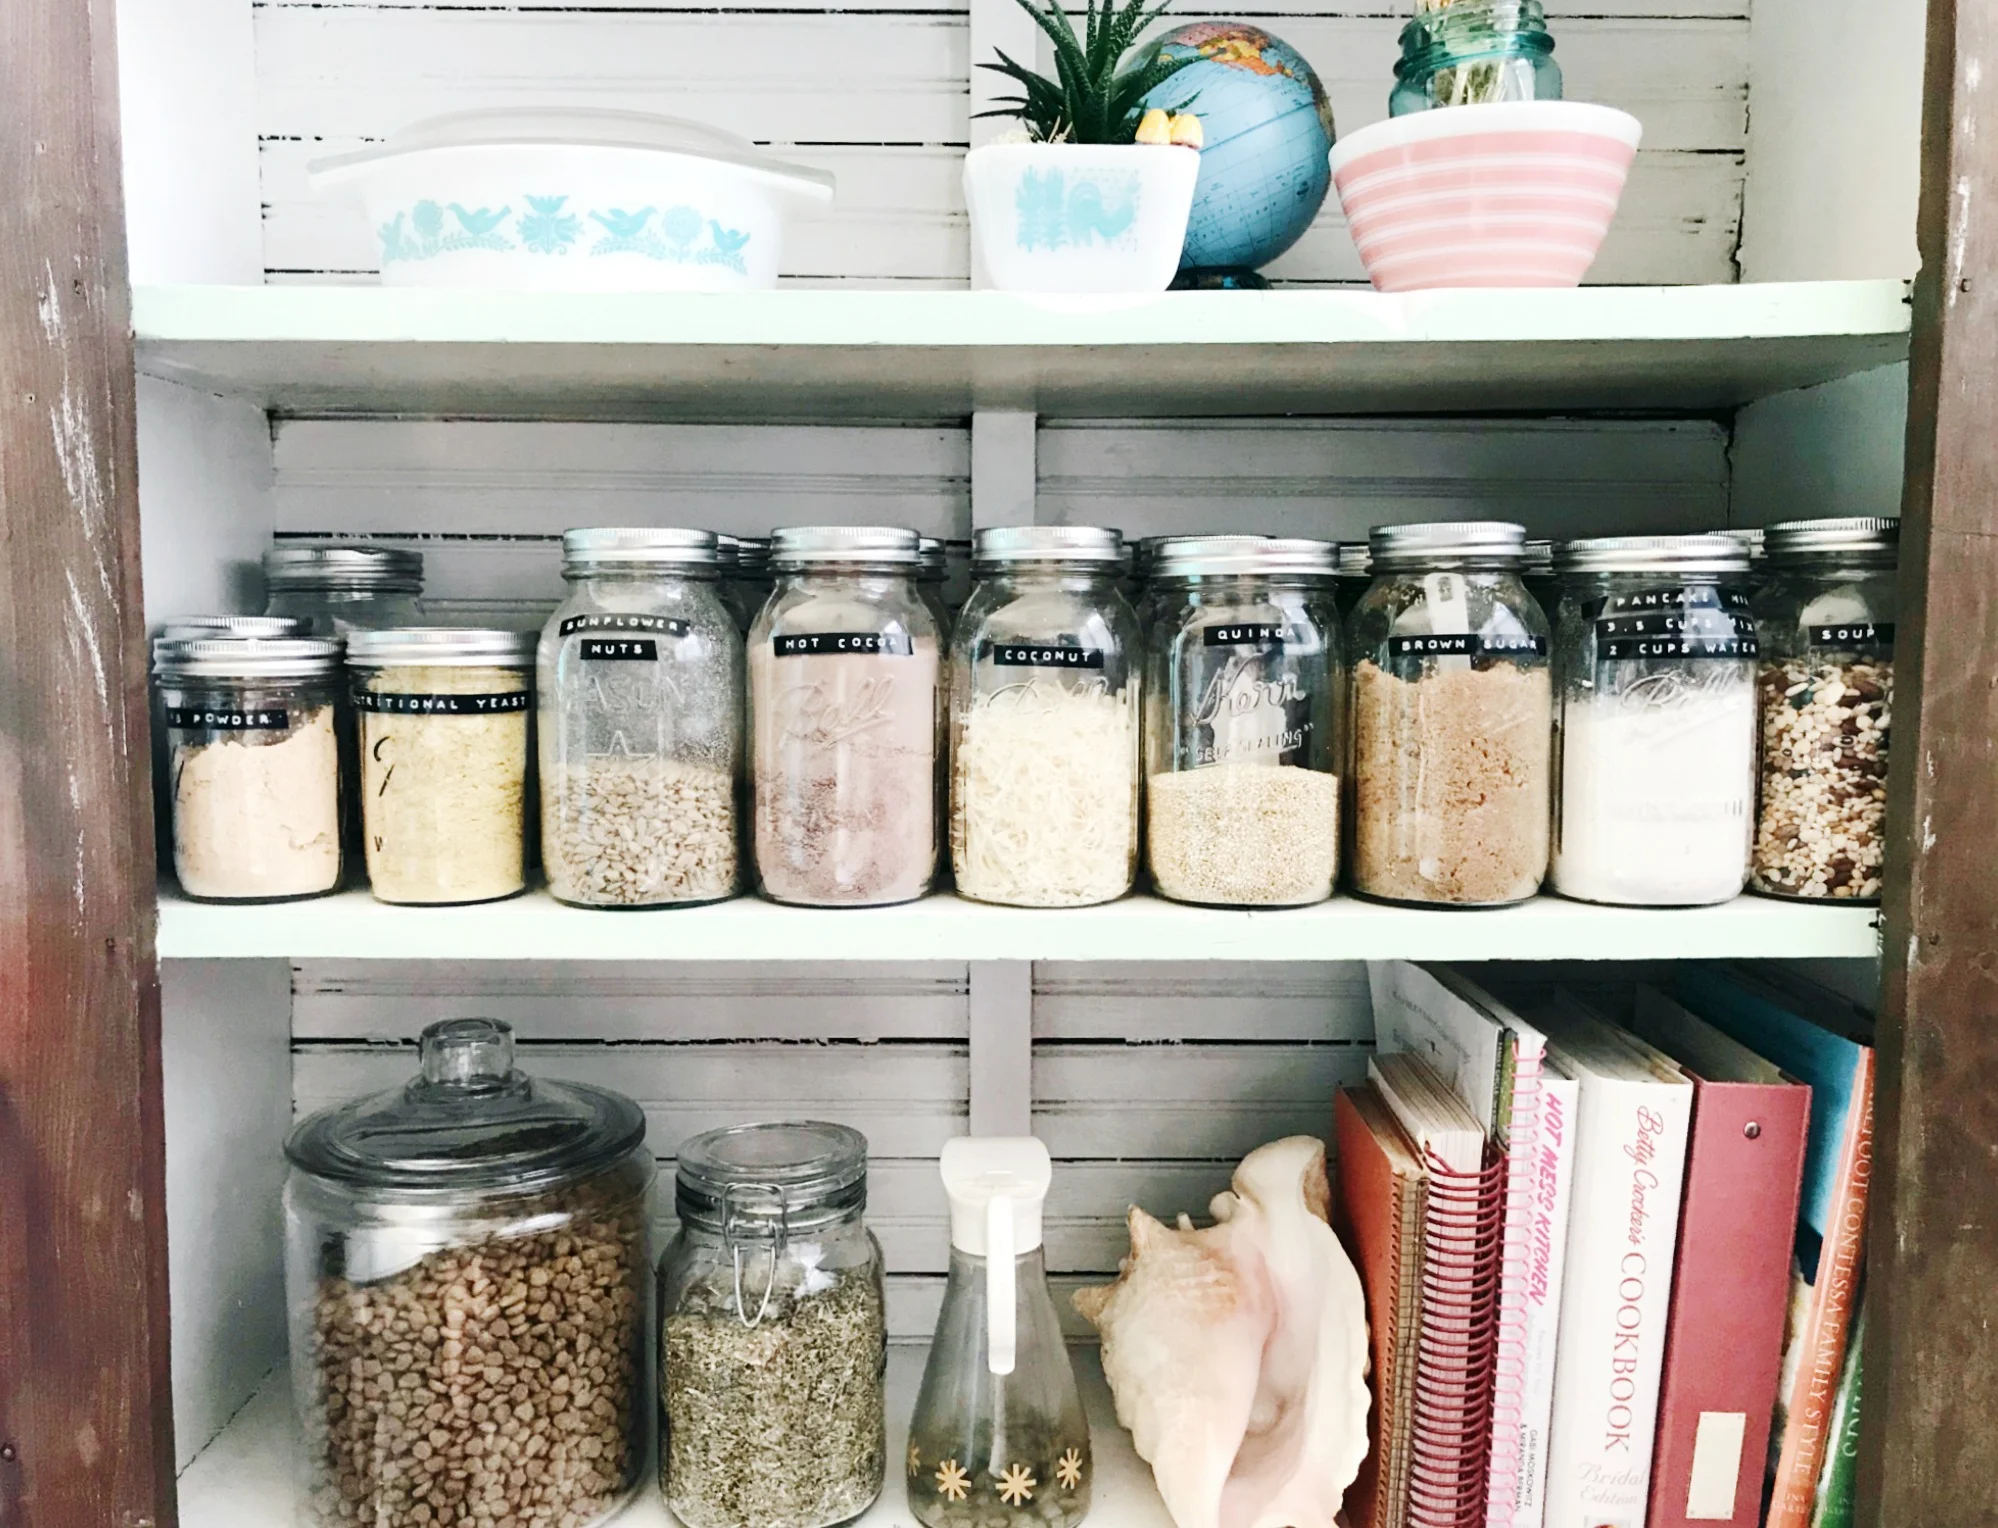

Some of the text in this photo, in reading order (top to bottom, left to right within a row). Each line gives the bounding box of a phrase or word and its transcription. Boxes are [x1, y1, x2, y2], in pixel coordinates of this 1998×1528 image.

[1616, 593, 1708, 607] PANCAKE
[566, 617, 678, 631] SUNFLOWER
[1665, 618, 1712, 630] CUPS
[1728, 617, 1754, 632] MIX
[1217, 628, 1295, 640] QUINOA
[1821, 629, 1875, 640] SOUP
[591, 644, 643, 655] NUTS
[785, 637, 898, 649] HOT COCOA
[1401, 639, 1537, 651] BROWN SUGAR
[1609, 642, 1756, 656] 2 CUPS WATER
[1004, 650, 1090, 662] COCONUT
[476, 696, 526, 709] YEAST
[193, 713, 269, 726] POWDER
[1544, 1092, 1564, 1148] HOT
[1537, 1144, 1560, 1212] MESS
[1528, 1211, 1552, 1306] KITCHEN
[1826, 1199, 1866, 1314] CONTESSA
[1605, 1105, 1664, 1452] Betty Crocker's COOKBOOK
[1809, 1320, 1840, 1404] FAMILY
[1792, 1407, 1823, 1475] STYLE
[1578, 1462, 1648, 1486] Bridal
[1523, 1455, 1536, 1508] MOSKOWITZ
[1580, 1484, 1638, 1506] Edition
